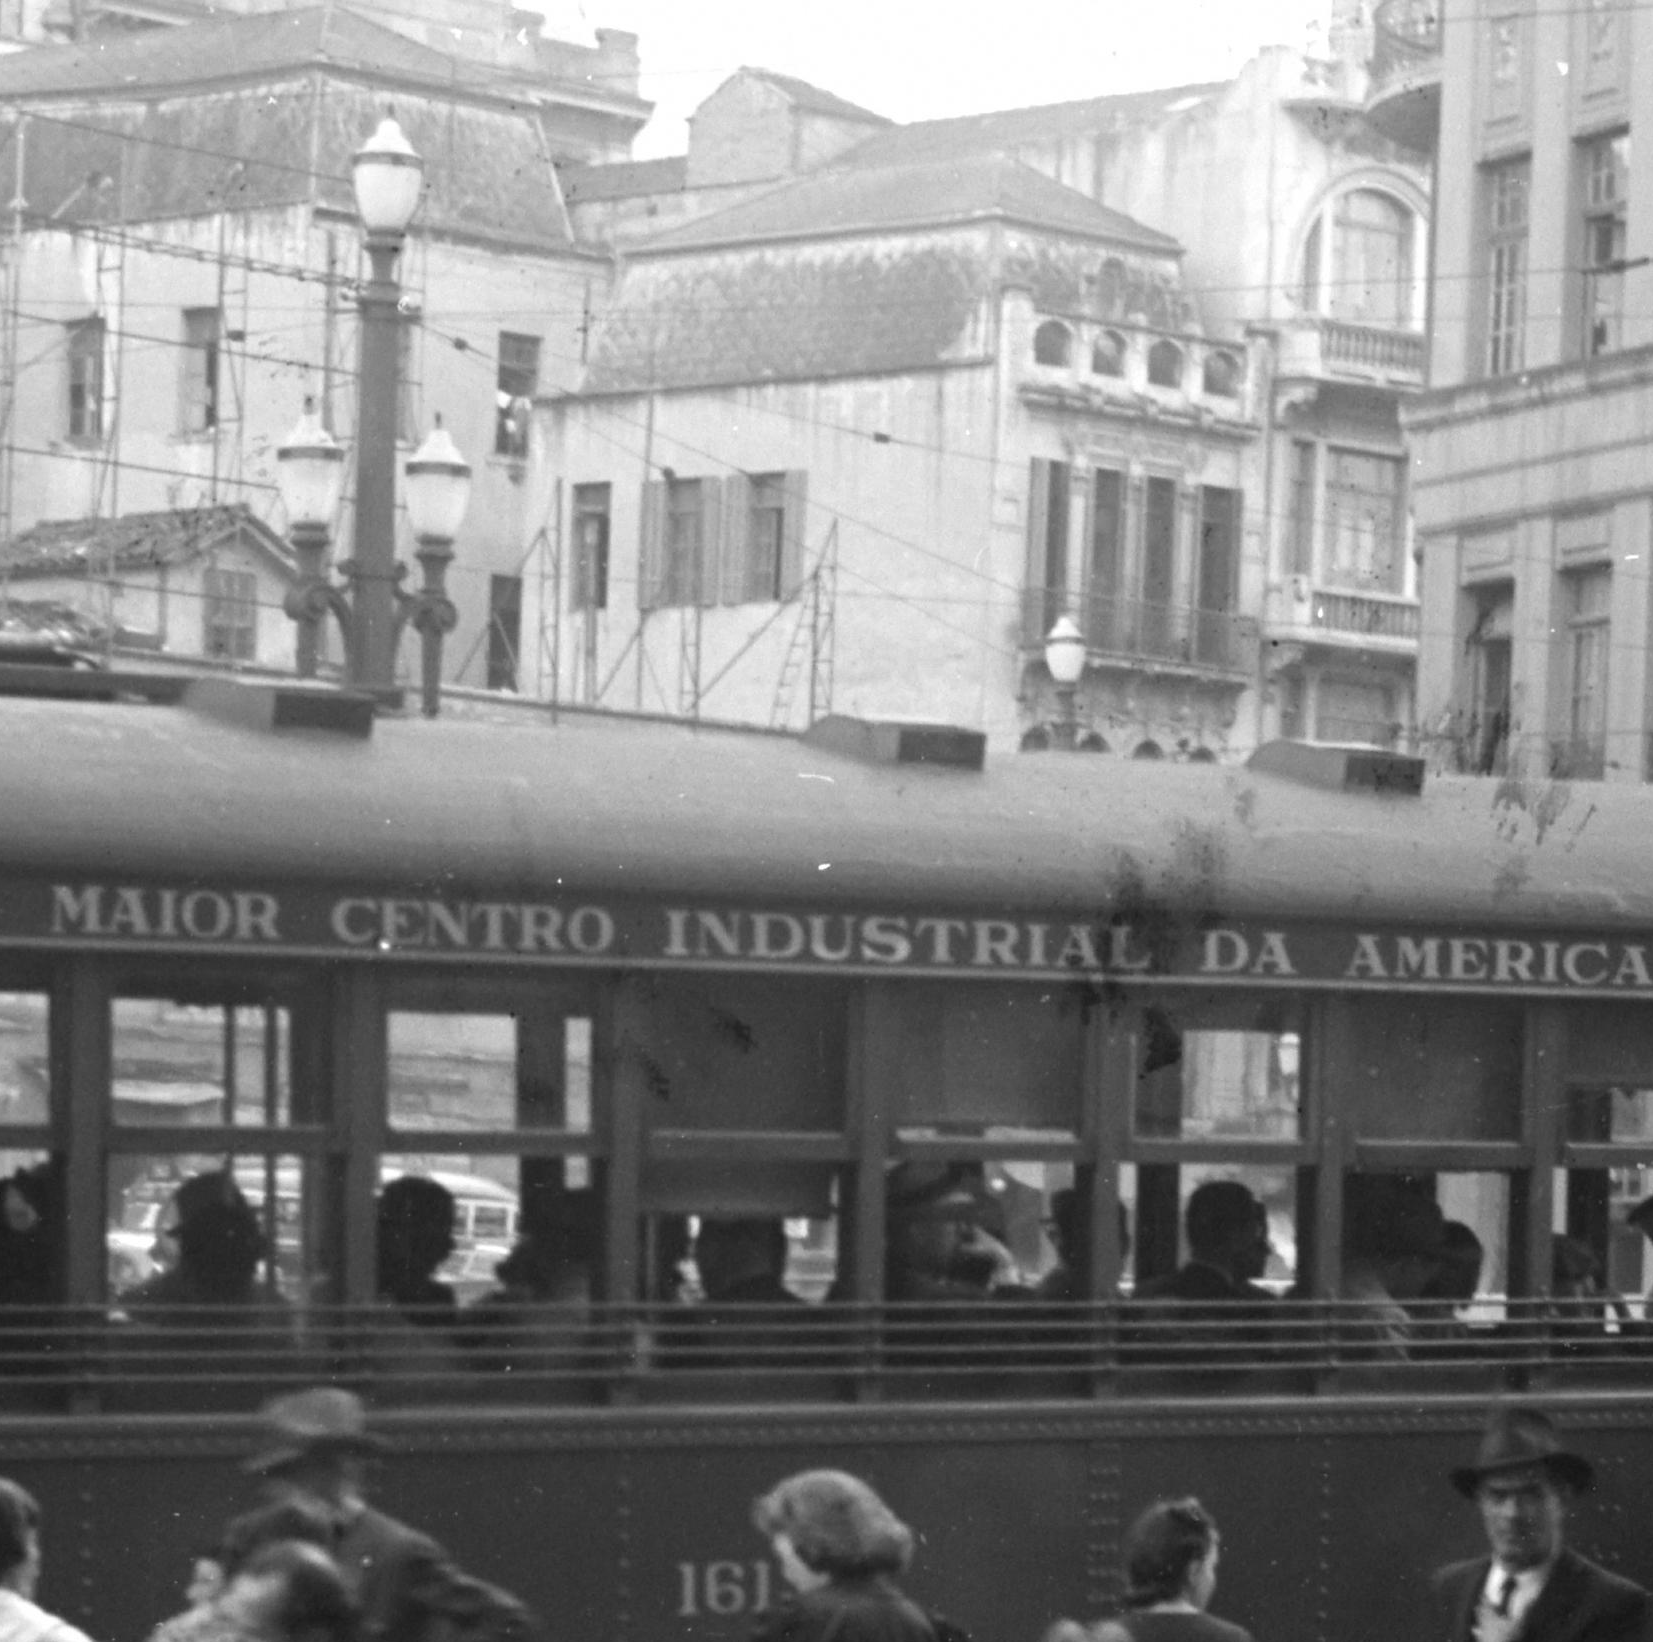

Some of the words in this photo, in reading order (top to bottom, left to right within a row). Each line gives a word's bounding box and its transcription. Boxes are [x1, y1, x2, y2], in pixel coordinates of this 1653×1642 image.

[50, 883, 283, 940] MAIOR
[331, 896, 616, 954] CENTRO
[663, 908, 1151, 970] INDUSTRIAL
[1200, 928, 1299, 976] DA
